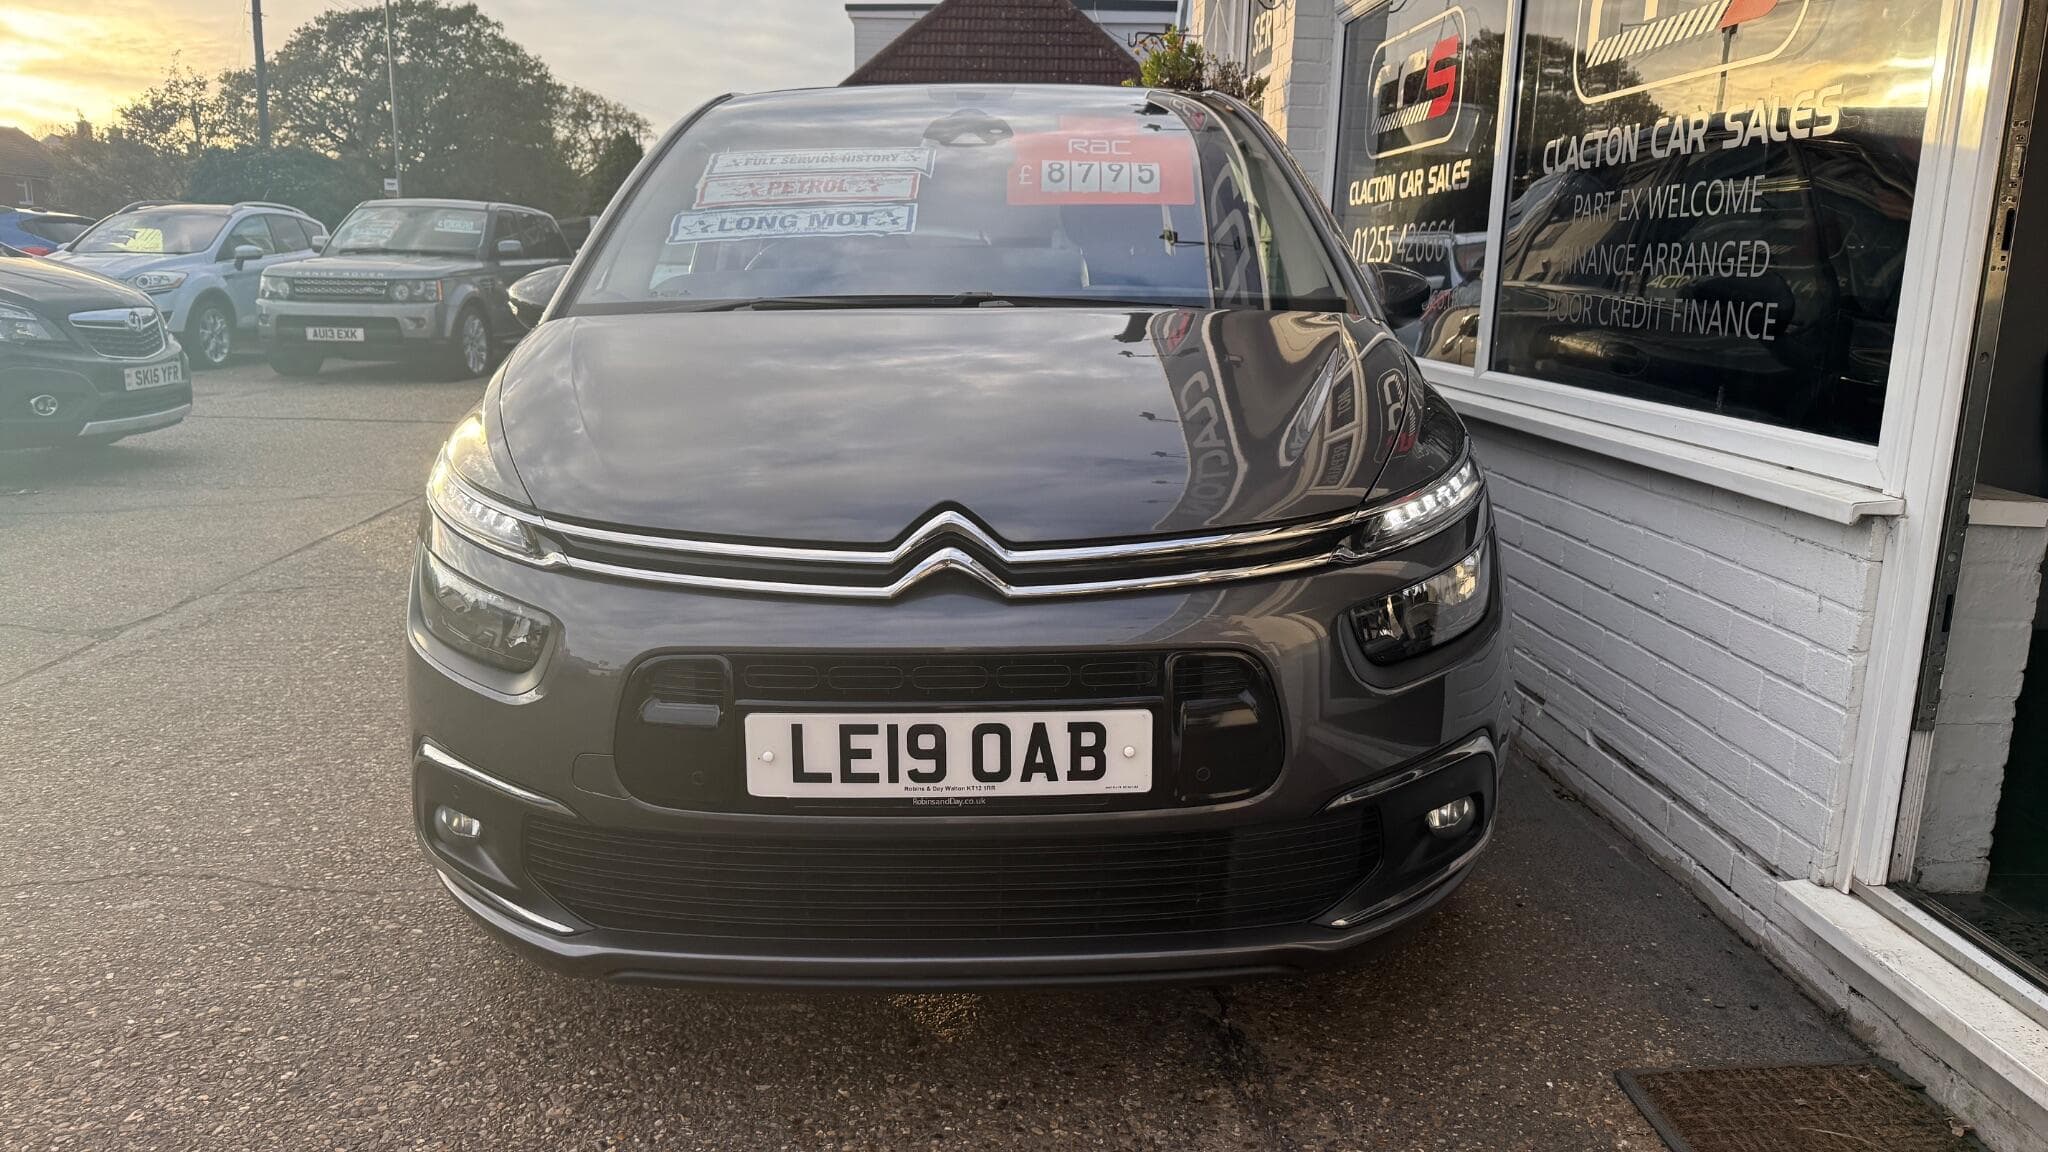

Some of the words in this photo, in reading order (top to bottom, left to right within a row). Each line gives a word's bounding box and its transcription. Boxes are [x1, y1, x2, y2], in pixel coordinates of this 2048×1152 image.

[1543, 123, 1640, 176] CLACTON
[1650, 111, 1709, 159] CAR
[1722, 84, 1844, 150] SALES
[744, 156, 777, 166] FULL
[781, 155, 838, 165] SERVICE
[841, 153, 898, 164] HISTORY
[765, 178, 850, 196] PETROL
[1349, 174, 1396, 206] CLACTON
[1399, 168, 1424, 198] CAR
[1427, 159, 1472, 195] SALES
[1573, 191, 1614, 224] PART
[1618, 187, 1642, 222] EX
[1648, 175, 1765, 219] WELCOME
[718, 212, 799, 233] LONG
[808, 210, 870, 229] MOT
[1352, 224, 1395, 263] 01255
[1560, 244, 1636, 276] FINANCE
[1640, 240, 1770, 278] ARRANGED
[313, 329, 334, 339] AU13
[337, 329, 357, 339] EXK
[1548, 294, 1593, 325] POOR
[1599, 296, 1666, 330] CREDIT
[1671, 299, 1778, 341] FINANCE
[162, 364, 179, 383] YFR
[791, 724, 947, 784] LE19
[972, 722, 1107, 782] OAB
